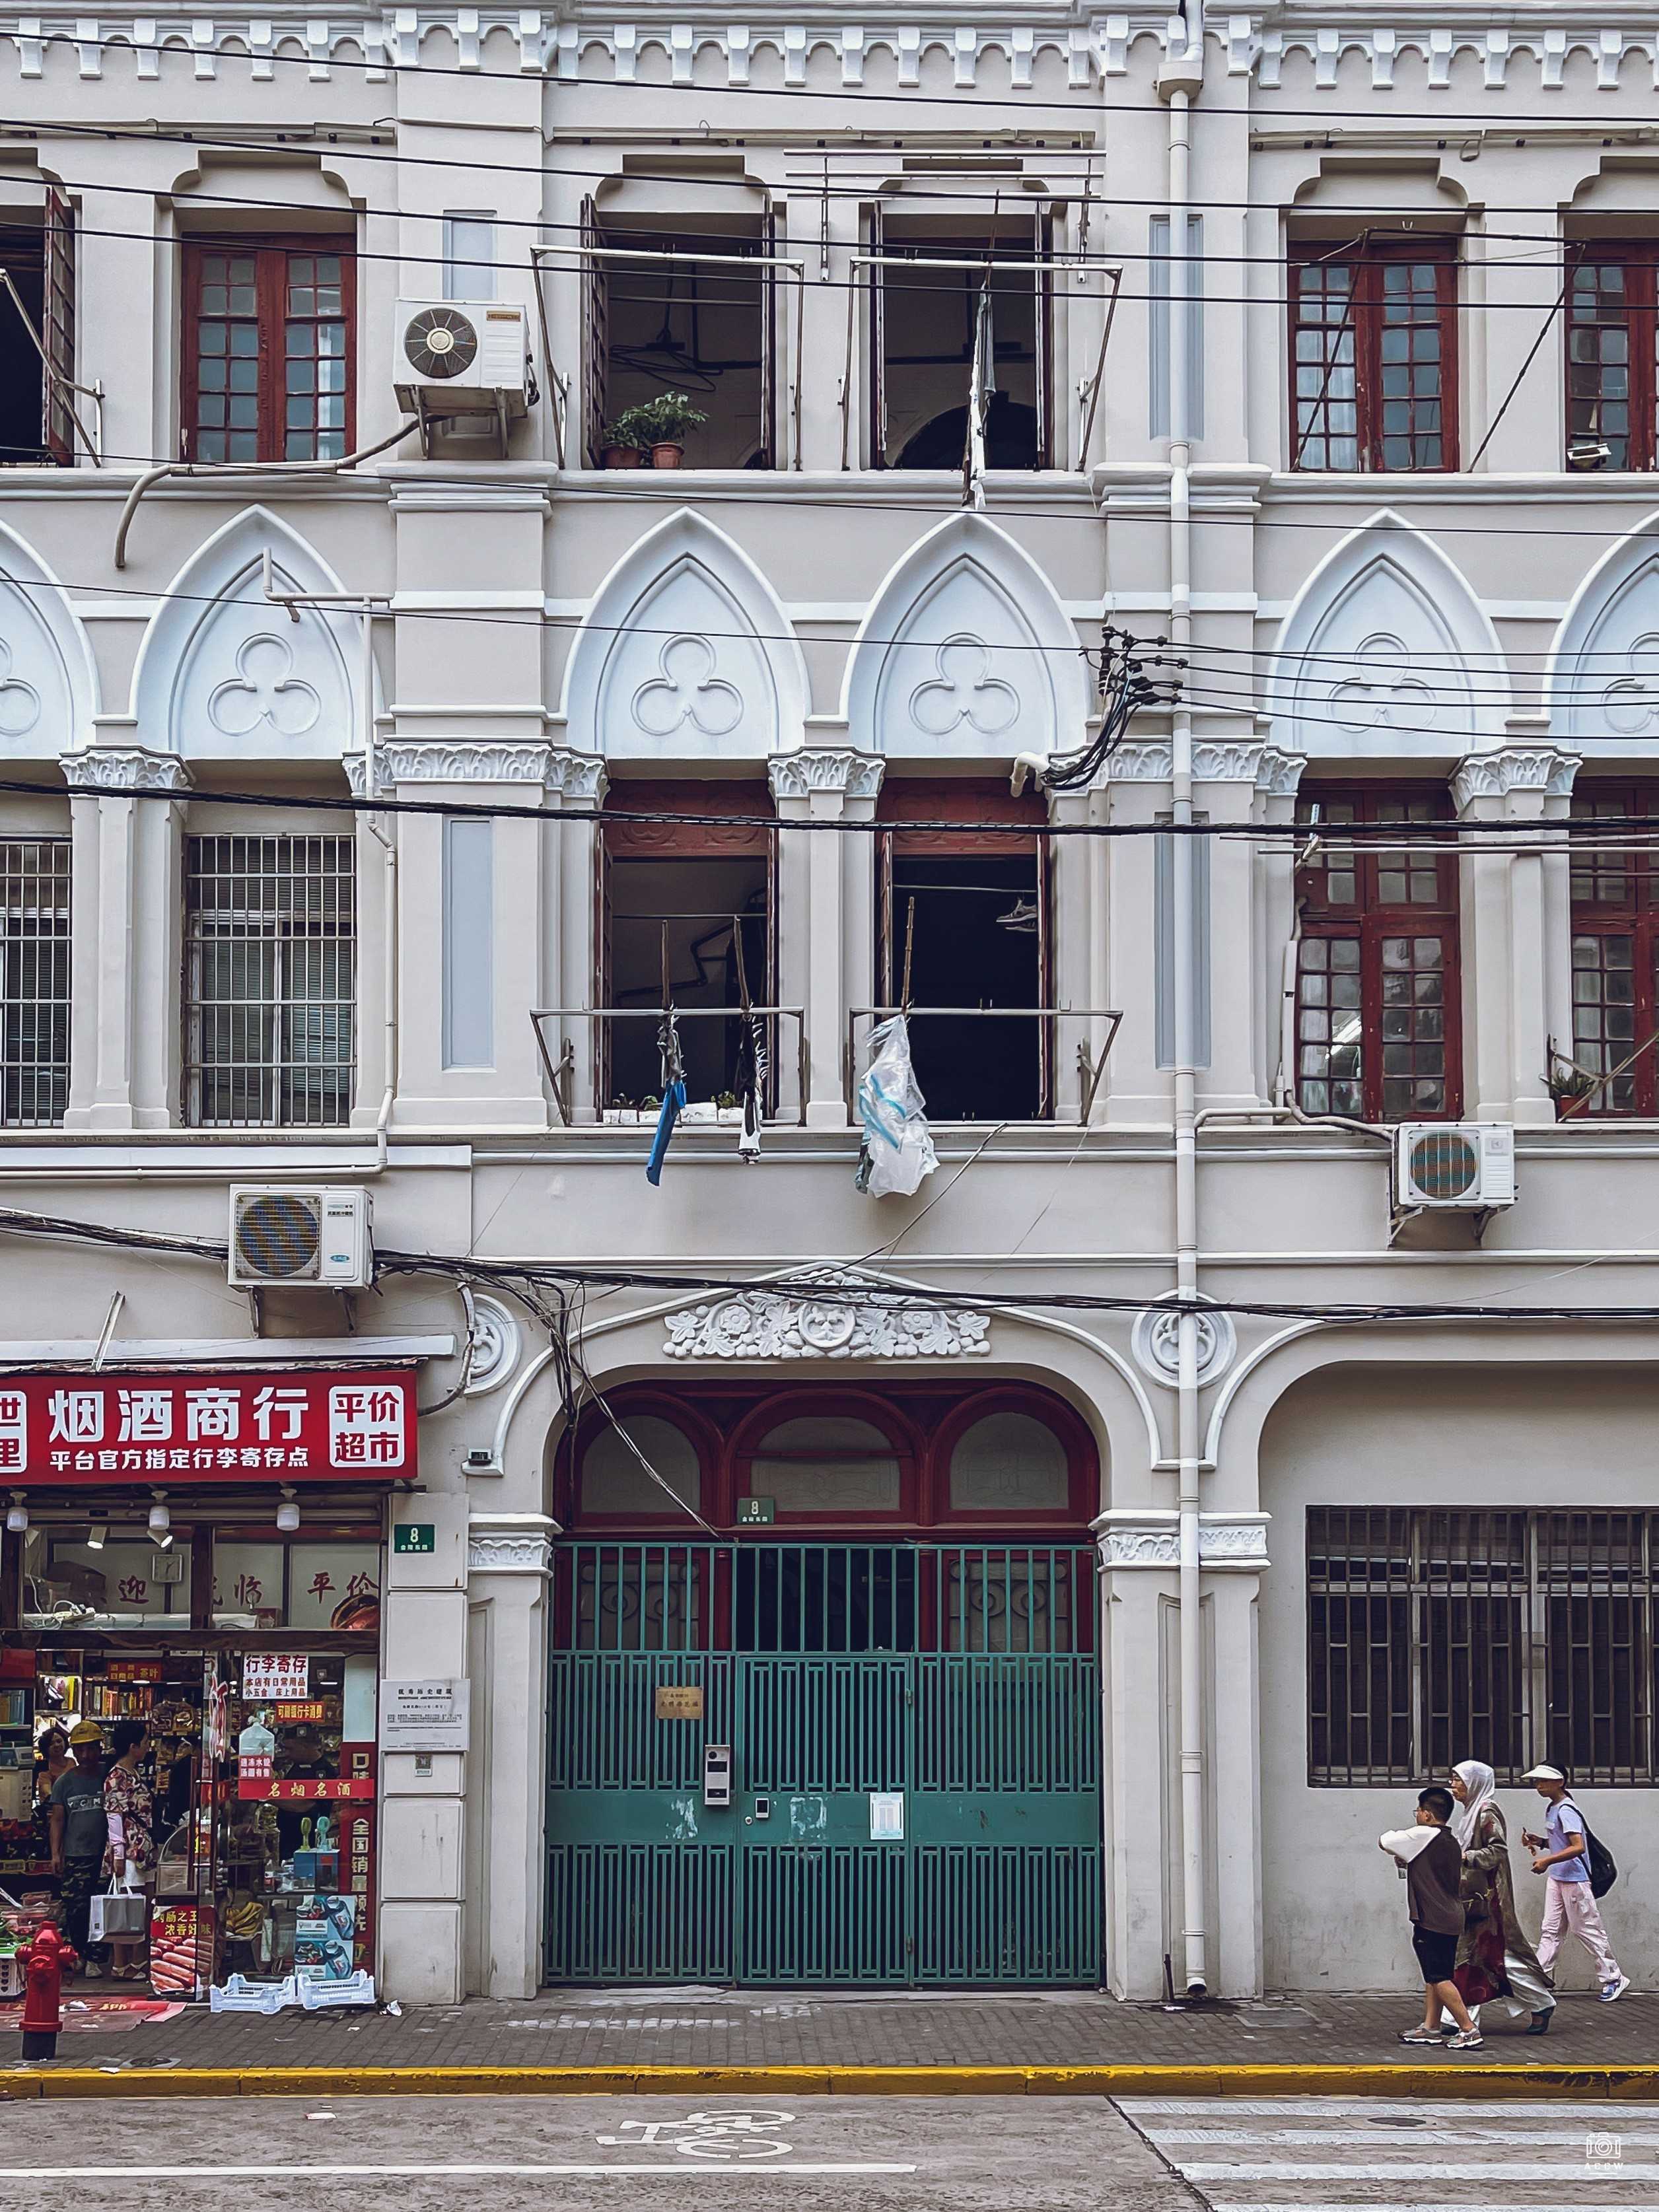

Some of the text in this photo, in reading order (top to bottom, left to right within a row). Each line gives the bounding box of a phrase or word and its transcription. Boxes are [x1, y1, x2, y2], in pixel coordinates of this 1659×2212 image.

[48, 1387, 308, 1443] 烟酒商行
[335, 1391, 400, 1423] 平价
[335, 1432, 400, 1463] 超市
[50, 1446, 308, 1471] 平台官方指定行李寄存点
[751, 1501, 759, 1515] 8
[410, 1527, 419, 1543] 8
[246, 1654, 306, 1673] 行李寄存
[246, 1677, 305, 1687] 本店有日常用品
[267, 1782, 351, 1797] 名烟名酒
